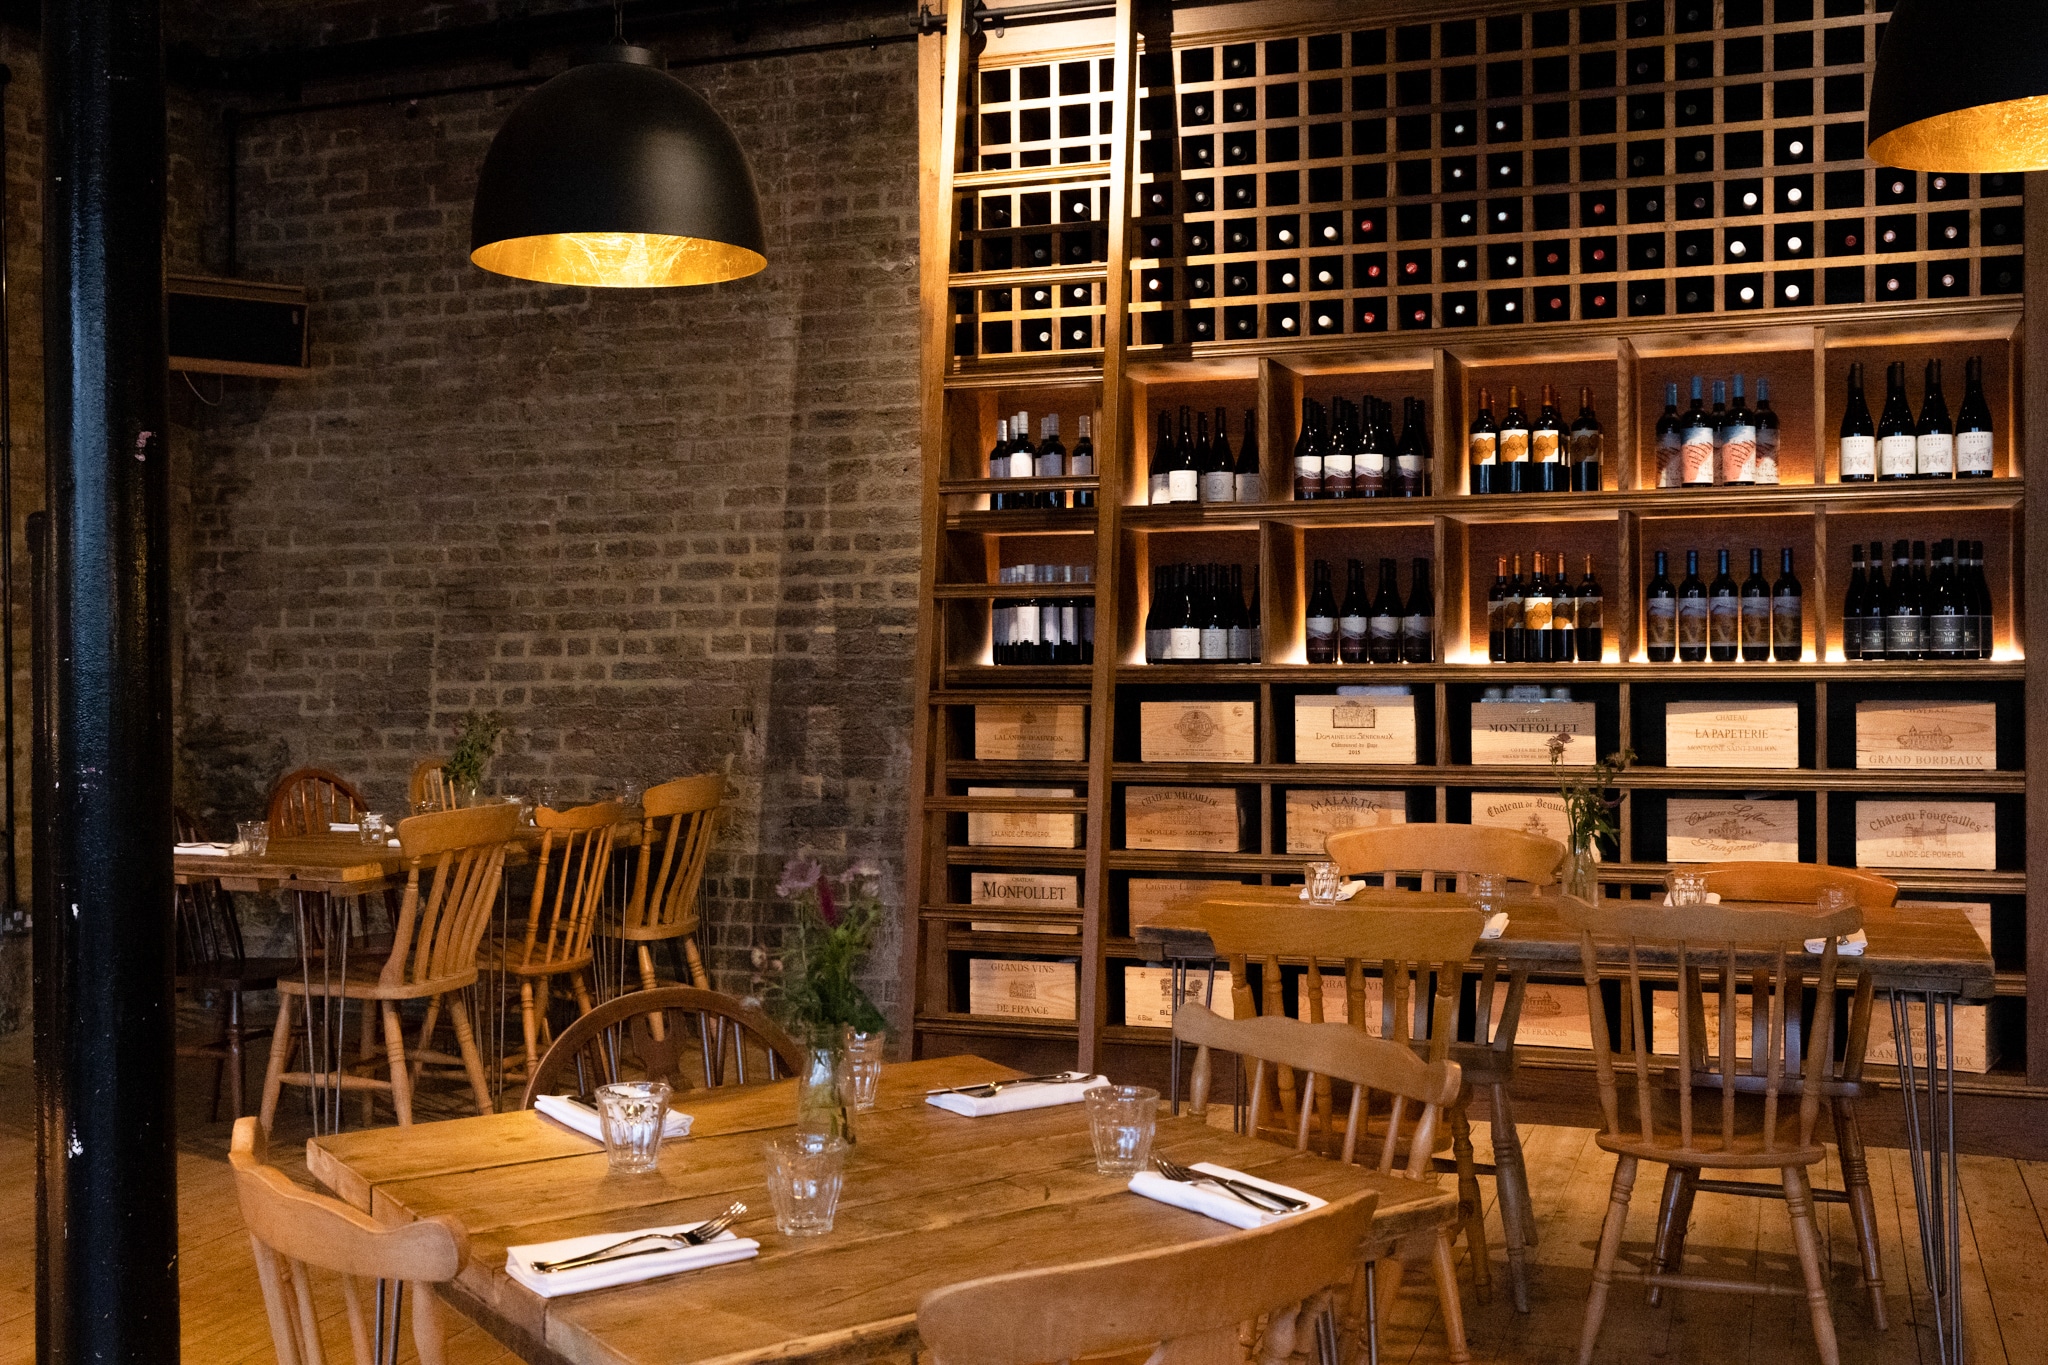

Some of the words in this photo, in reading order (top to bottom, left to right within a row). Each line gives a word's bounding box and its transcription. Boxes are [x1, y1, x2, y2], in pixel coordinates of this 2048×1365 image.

[1489, 723, 1579, 733] MONTFOLLET
[1695, 728, 1709, 739] LA
[1711, 728, 1769, 739] PAPETERIE
[1868, 754, 1911, 765] GRAND
[1915, 755, 1983, 766] BORDEAUX
[1310, 796, 1382, 814] MALARTIC
[1487, 801, 1524, 818] Château
[1868, 811, 1916, 832] Château
[1918, 809, 1982, 833] Fougeailles
[981, 880, 1066, 901] MONFOLLET
[990, 962, 1029, 973] GRANDS
[1031, 964, 1055, 974] VINS
[996, 1003, 1009, 1013] DE
[1011, 1004, 1049, 1015] FRANCE
